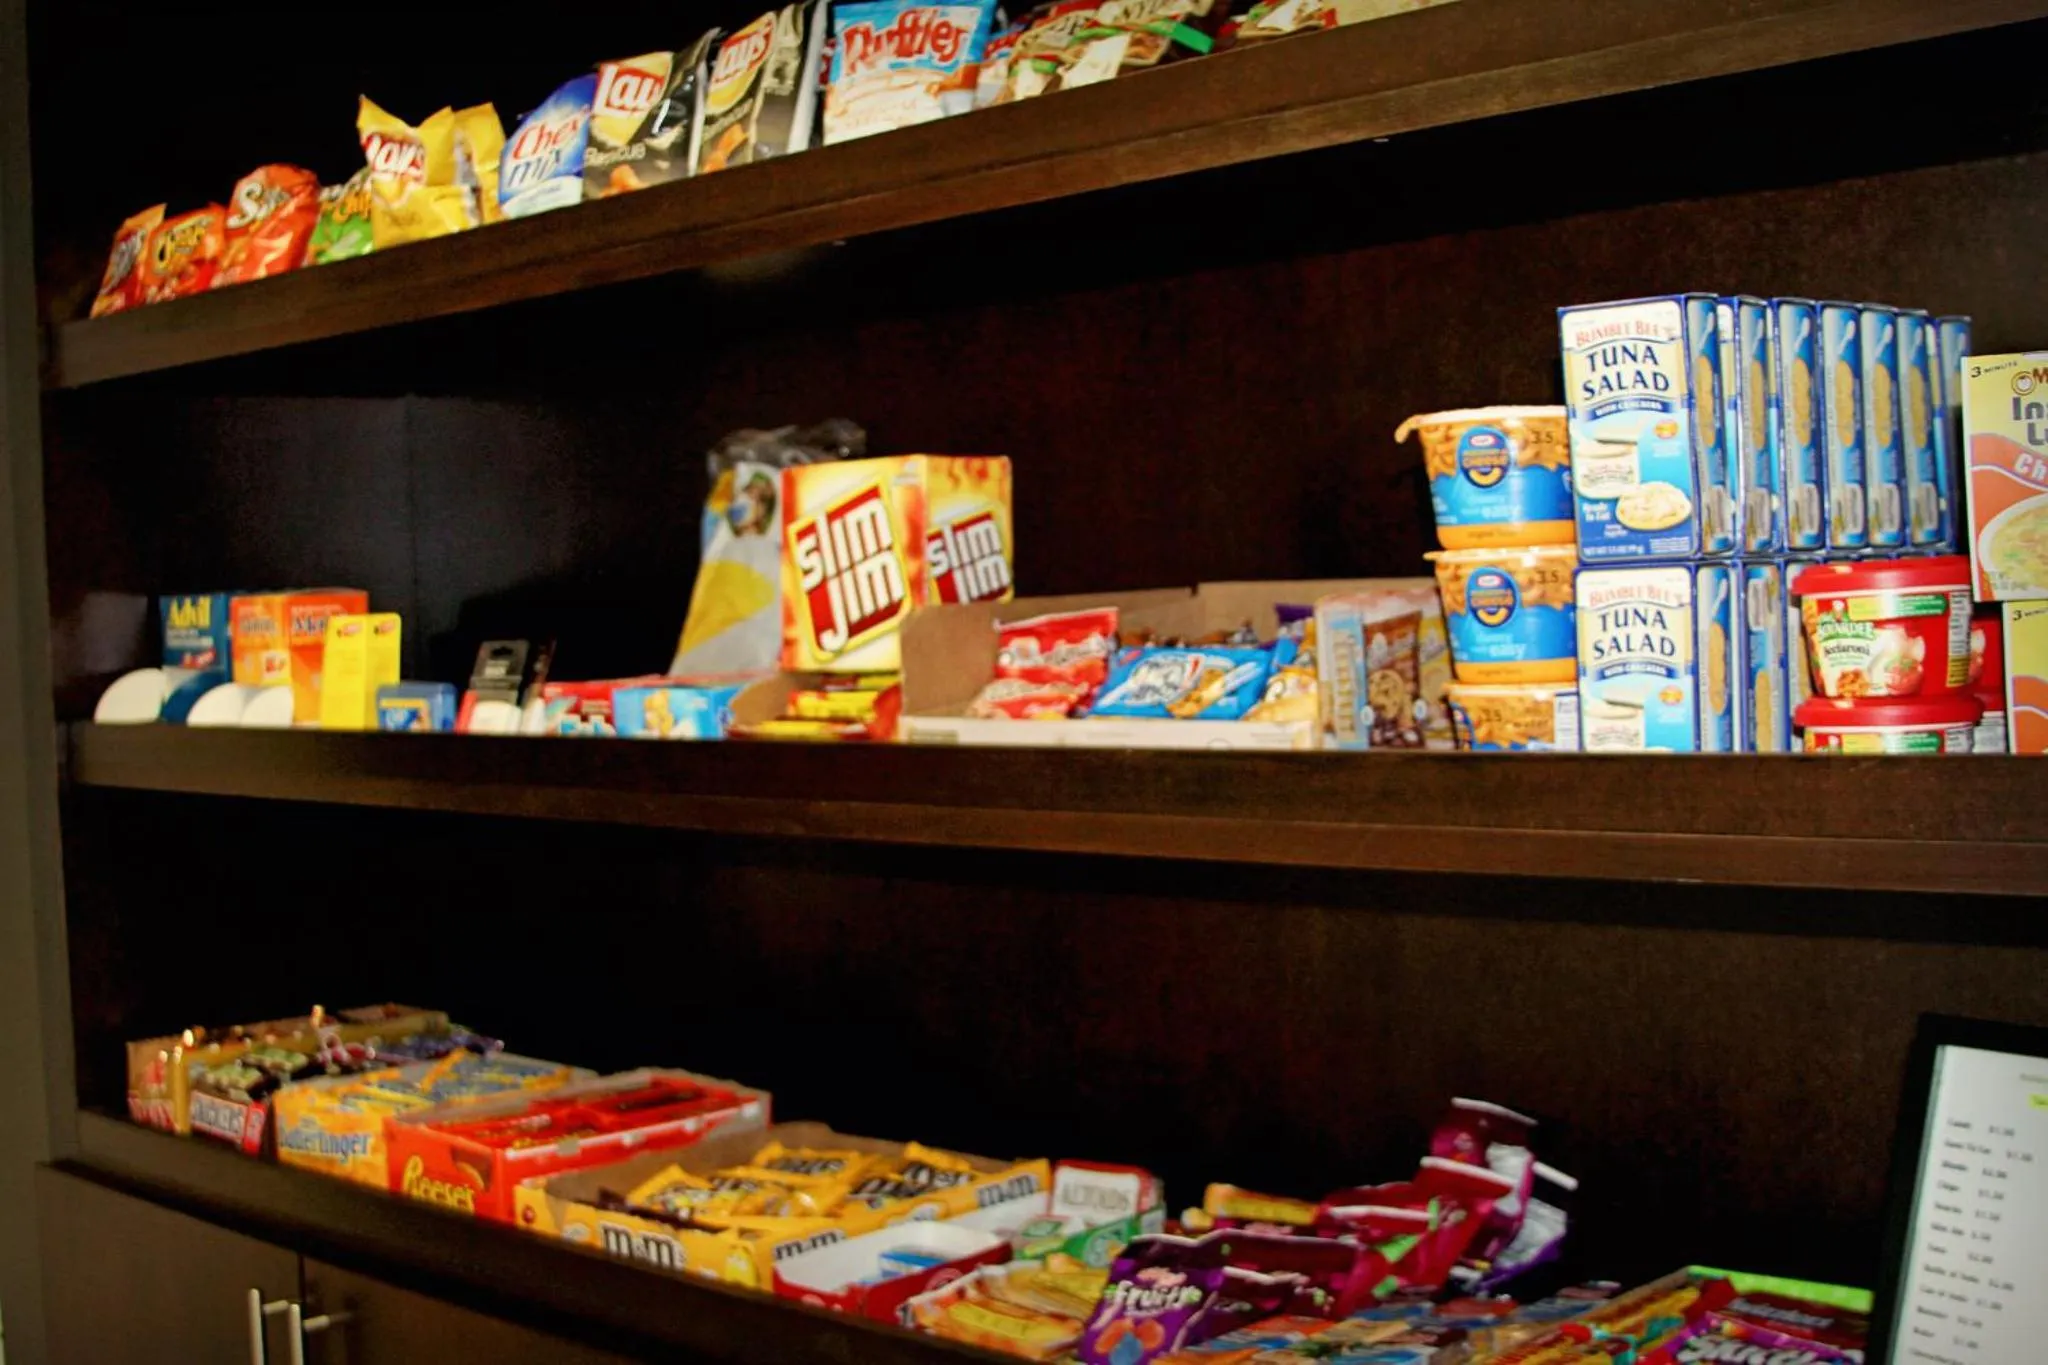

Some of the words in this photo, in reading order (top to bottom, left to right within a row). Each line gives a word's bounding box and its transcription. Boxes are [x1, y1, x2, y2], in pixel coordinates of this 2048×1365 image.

[843, 8, 968, 75] Ruffles
[1587, 344, 1659, 372] TUNA
[1970, 366, 1981, 378] 3
[1582, 369, 1669, 401] SALAD
[2012, 396, 2048, 421] In
[798, 498, 893, 592] slim
[928, 519, 1003, 579] slim
[1599, 607, 1667, 633] TUNA
[1592, 633, 1677, 661] SALAD
